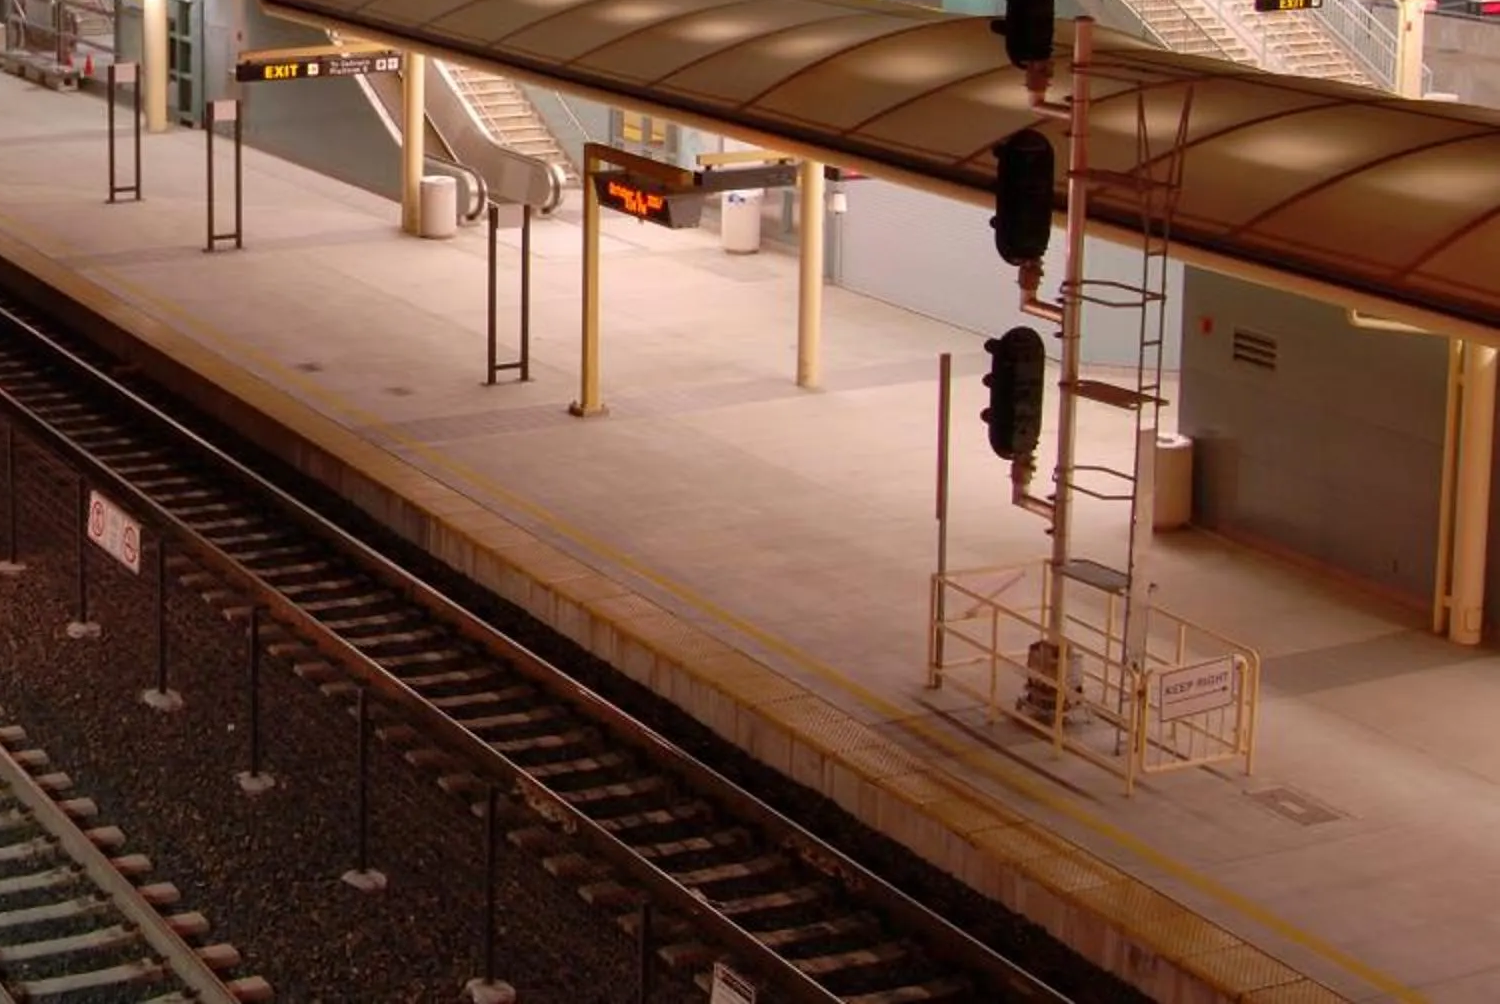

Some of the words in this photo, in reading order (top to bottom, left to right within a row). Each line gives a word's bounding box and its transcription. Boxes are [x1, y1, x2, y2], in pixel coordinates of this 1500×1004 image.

[264, 63, 299, 79] EXIT
[1165, 680, 1194, 695] KEEP
[1197, 670, 1228, 687] RIGHT
